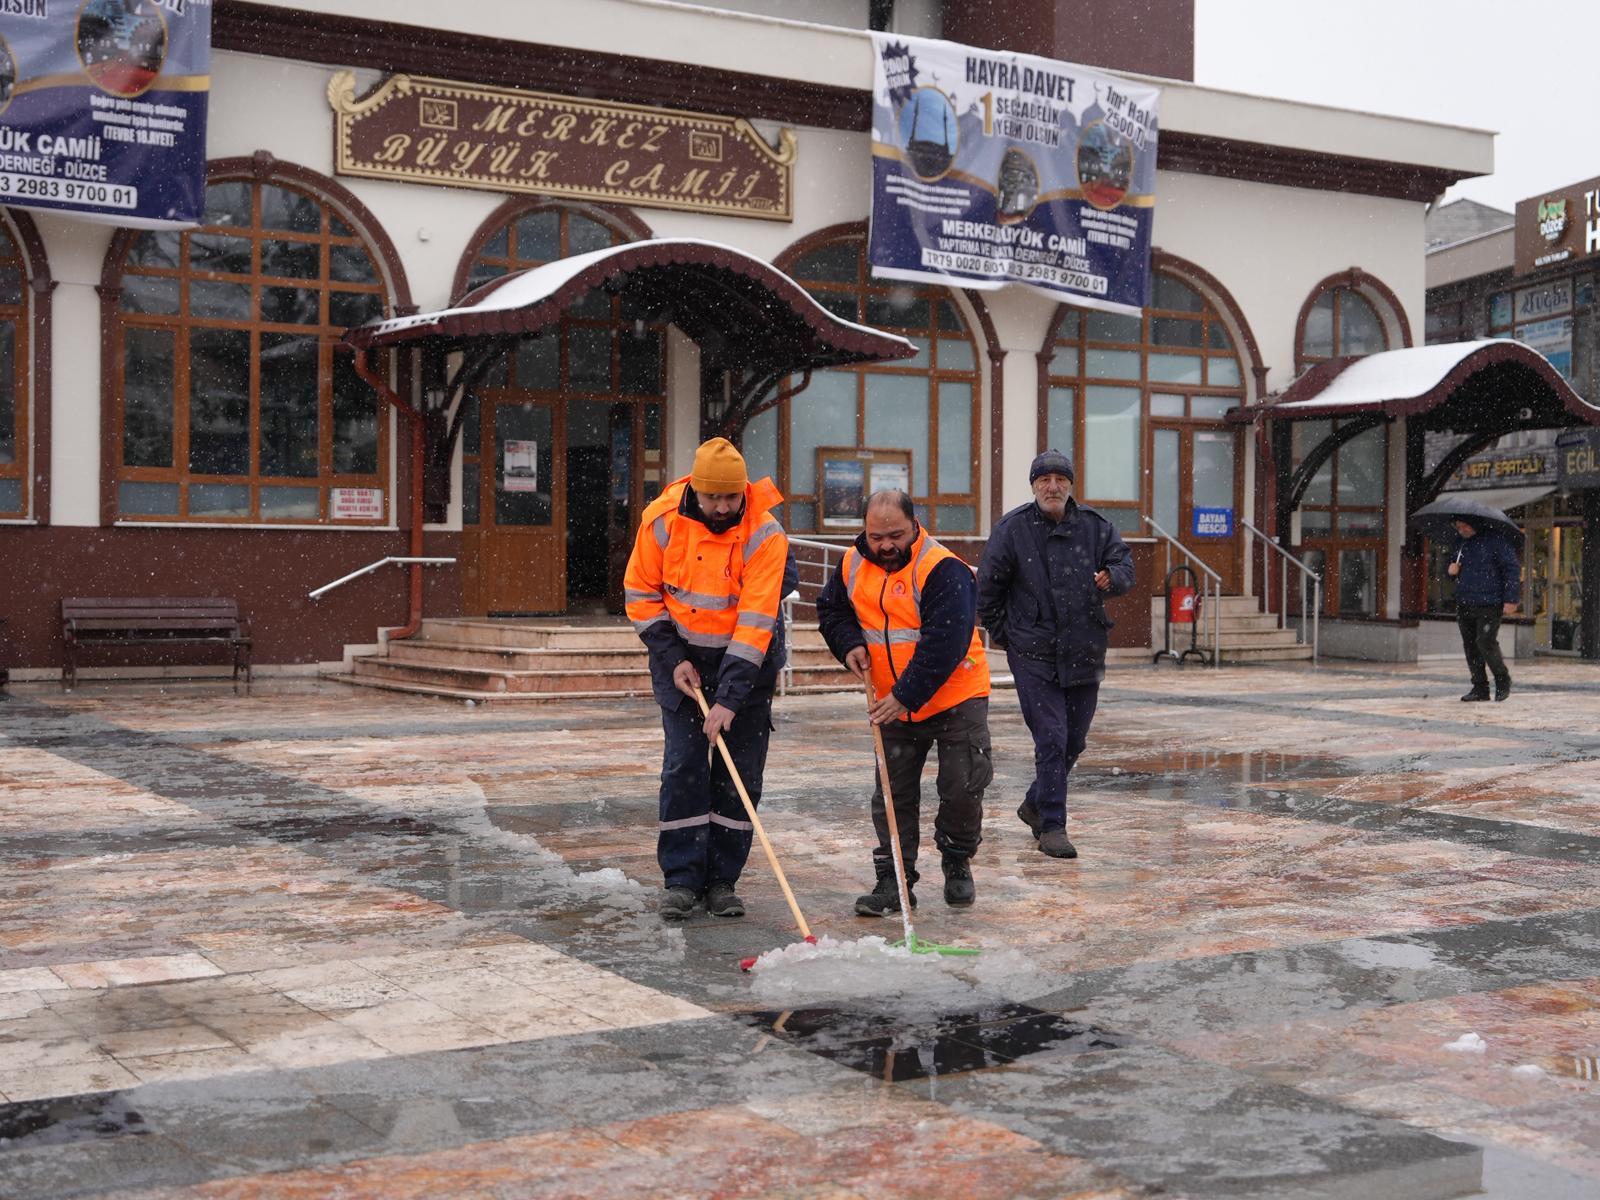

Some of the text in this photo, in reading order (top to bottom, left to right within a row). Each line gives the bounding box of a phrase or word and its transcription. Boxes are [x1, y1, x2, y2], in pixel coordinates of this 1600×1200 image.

[0, 0, 45, 16] LSUN
[1022, 67, 1076, 103] DAVET
[472, 105, 669, 152] MERKEZ
[980, 91, 993, 135] 1
[1105, 107, 1134, 138] 2500
[37, 133, 101, 161] CAMİİ
[64, 158, 107, 181] DÜZCE
[373, 133, 760, 200] BÜYÜK CAMİİ
[17, 178, 60, 197] 2983
[65, 183, 107, 202] 9700
[113, 188, 132, 205] 01
[955, 256, 981, 271] 0020
[1026, 265, 1057, 281] 2983
[1060, 272, 1090, 288] 9700
[1092, 278, 1105, 291] 01
[1199, 513, 1226, 522] BAYAN
